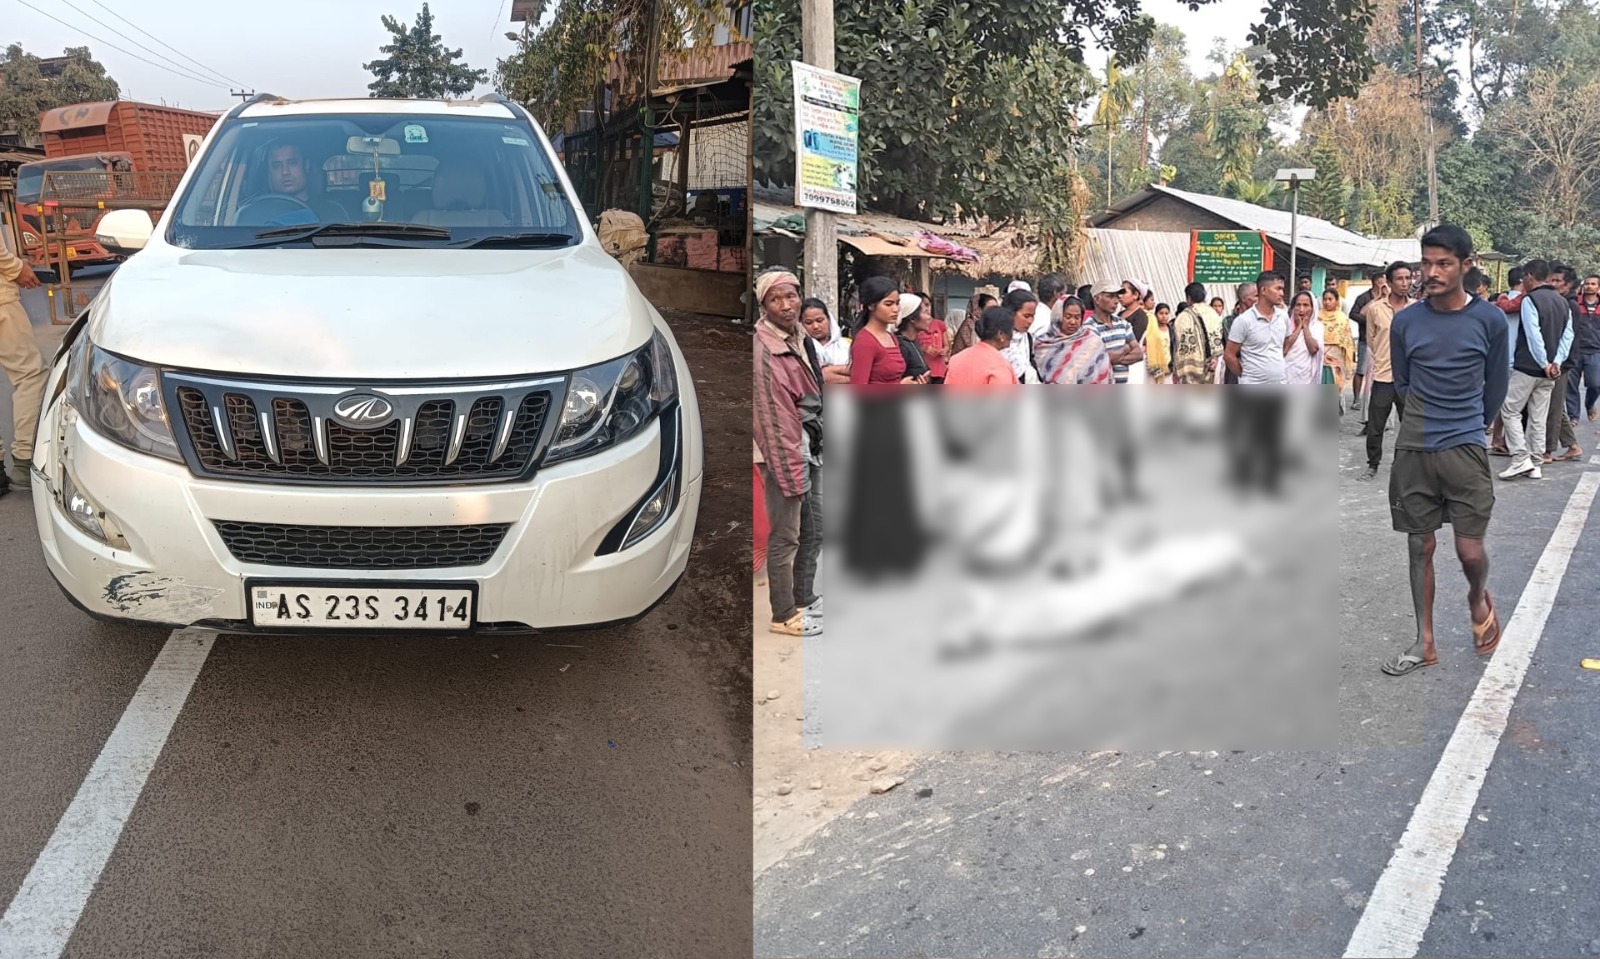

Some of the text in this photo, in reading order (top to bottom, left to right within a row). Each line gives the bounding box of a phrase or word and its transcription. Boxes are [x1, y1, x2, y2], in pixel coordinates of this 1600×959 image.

[255, 601, 272, 609] IND
[277, 593, 468, 621] AS 23S 3414
